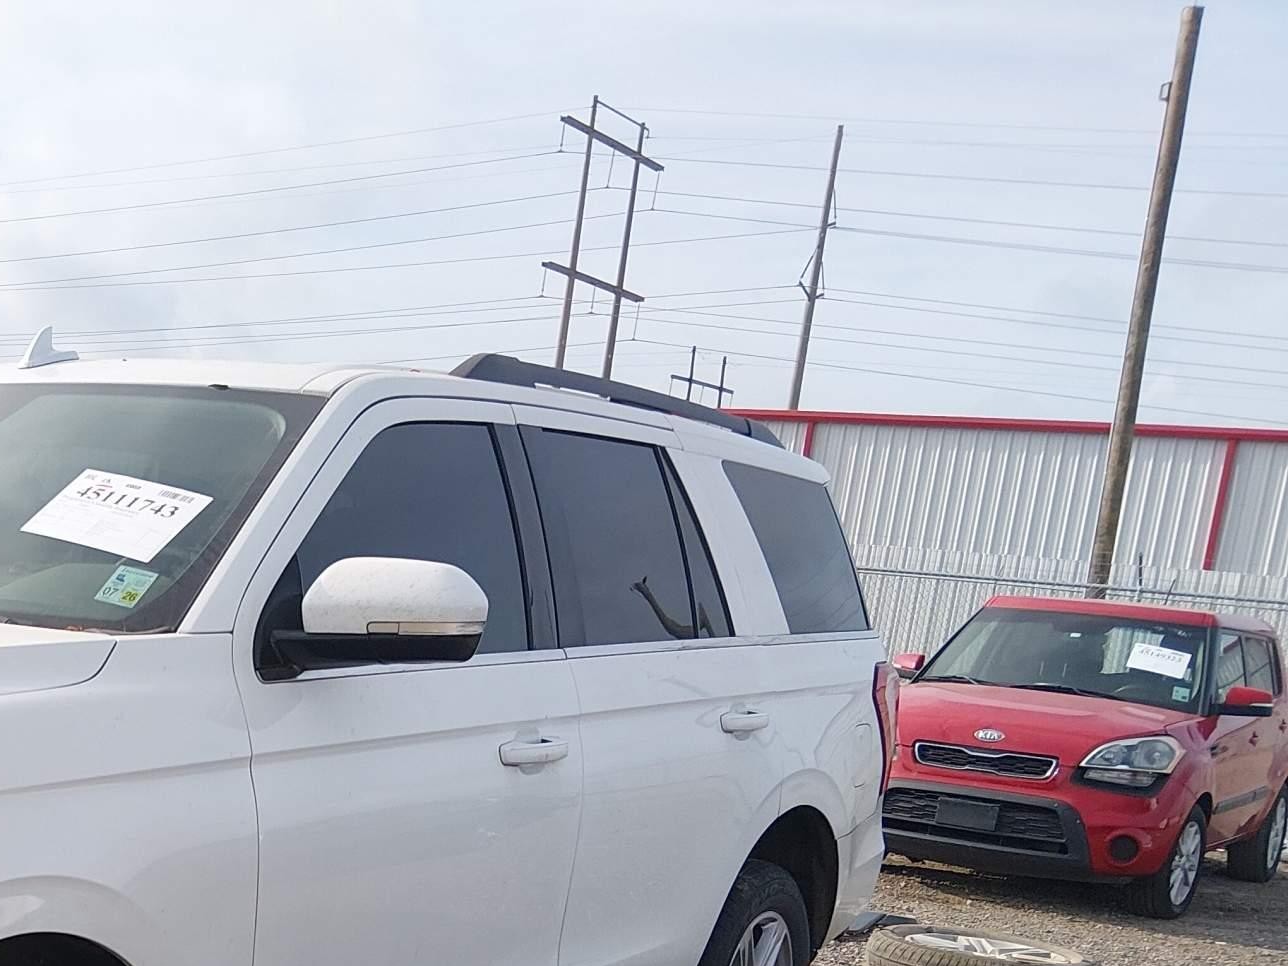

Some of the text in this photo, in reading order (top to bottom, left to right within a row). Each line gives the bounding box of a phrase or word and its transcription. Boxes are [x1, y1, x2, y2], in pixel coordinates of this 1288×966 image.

[76, 485, 180, 519] 45111743
[102, 586, 139, 602] 07 26
[977, 730, 1003, 741] KIA
